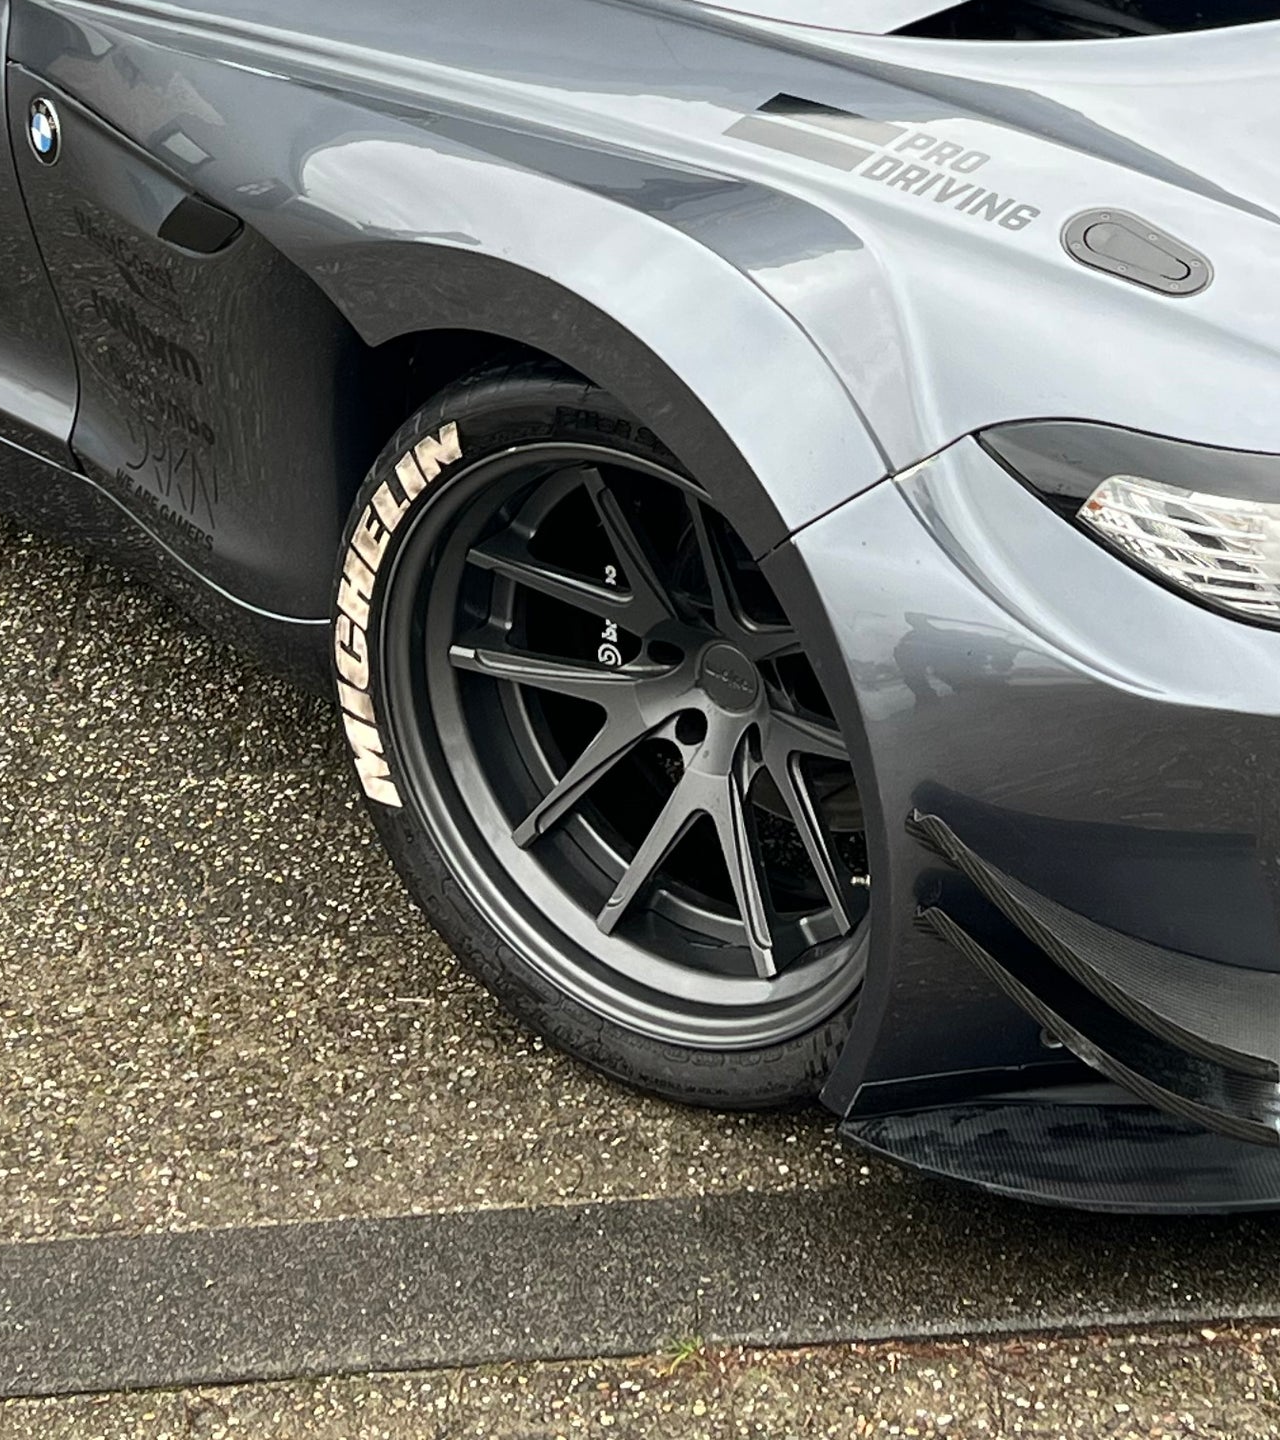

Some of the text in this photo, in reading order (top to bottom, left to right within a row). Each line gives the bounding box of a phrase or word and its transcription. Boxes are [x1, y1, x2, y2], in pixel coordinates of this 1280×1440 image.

[860, 155, 1041, 231] DRIVING
[894, 132, 991, 174] PRO
[115, 467, 215, 551] WE ARE GAMERS
[333, 420, 463, 809] MICHELIN
